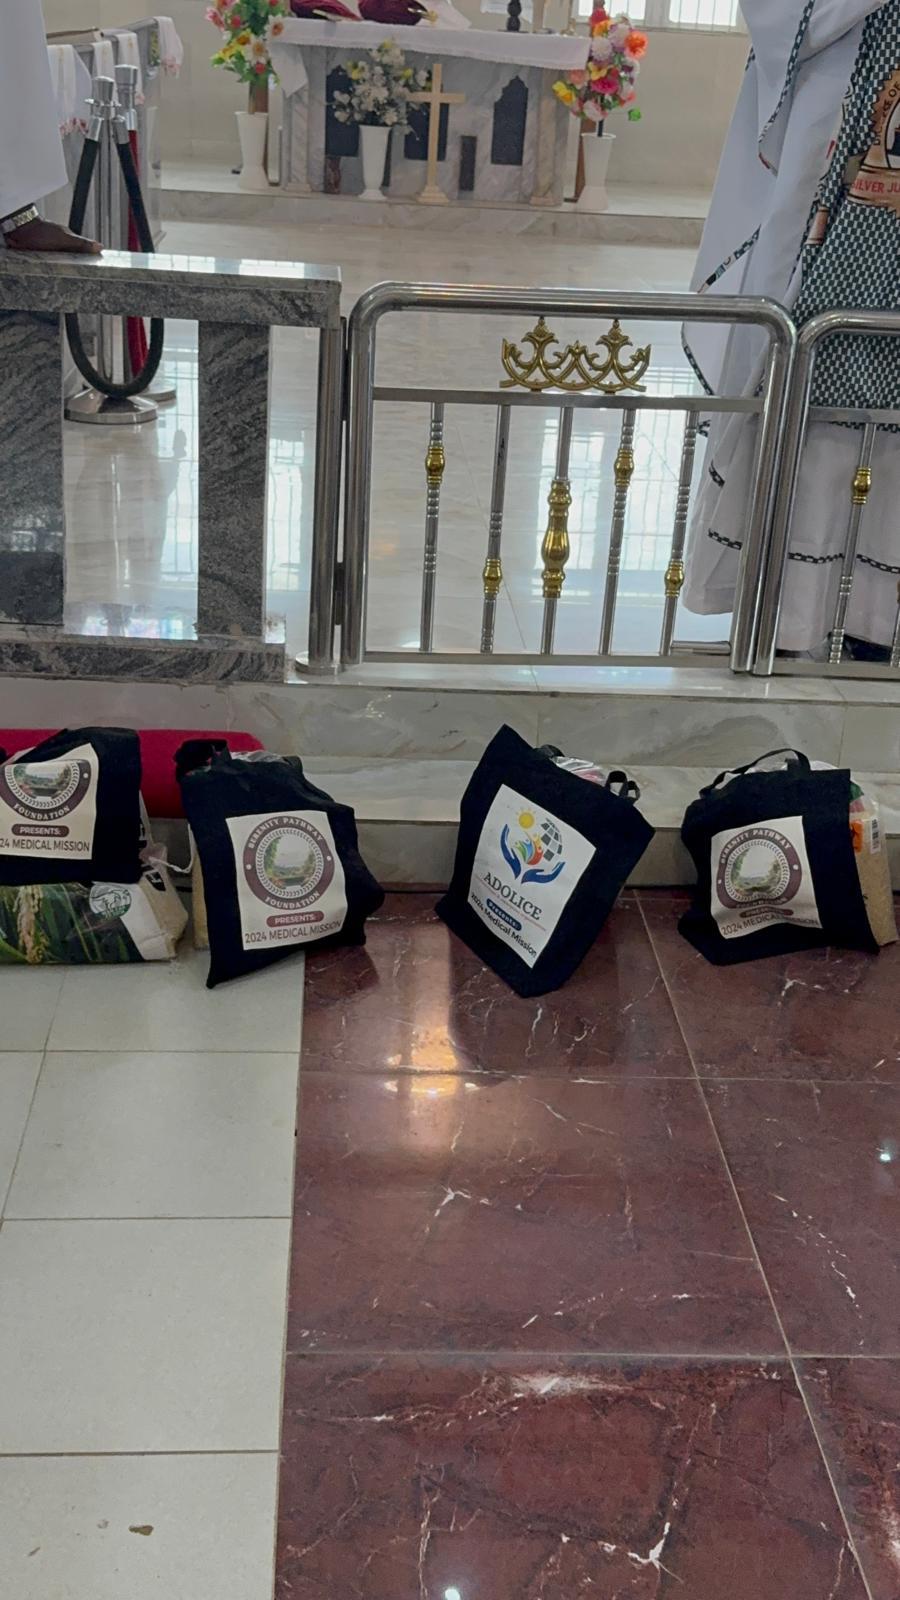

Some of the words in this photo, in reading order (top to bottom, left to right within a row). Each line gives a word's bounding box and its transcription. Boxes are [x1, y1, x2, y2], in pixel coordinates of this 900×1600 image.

[13, 803, 71, 820] FOUNDATION
[283, 816, 324, 841] PATHWAY
[12, 839, 52, 850] MEDICAL
[53, 840, 90, 852] MISSION
[752, 829, 792, 849] PATHWAY
[265, 891, 320, 909] FOUNDATION
[483, 872, 542, 920] ADOLICE
[245, 931, 267, 944] 2024
[269, 927, 308, 940] MEDICAL
[309, 920, 341, 934] MISSION
[484, 908, 511, 936] Medical
[511, 931, 537, 958] Mission
[721, 923, 742, 936] 2024
